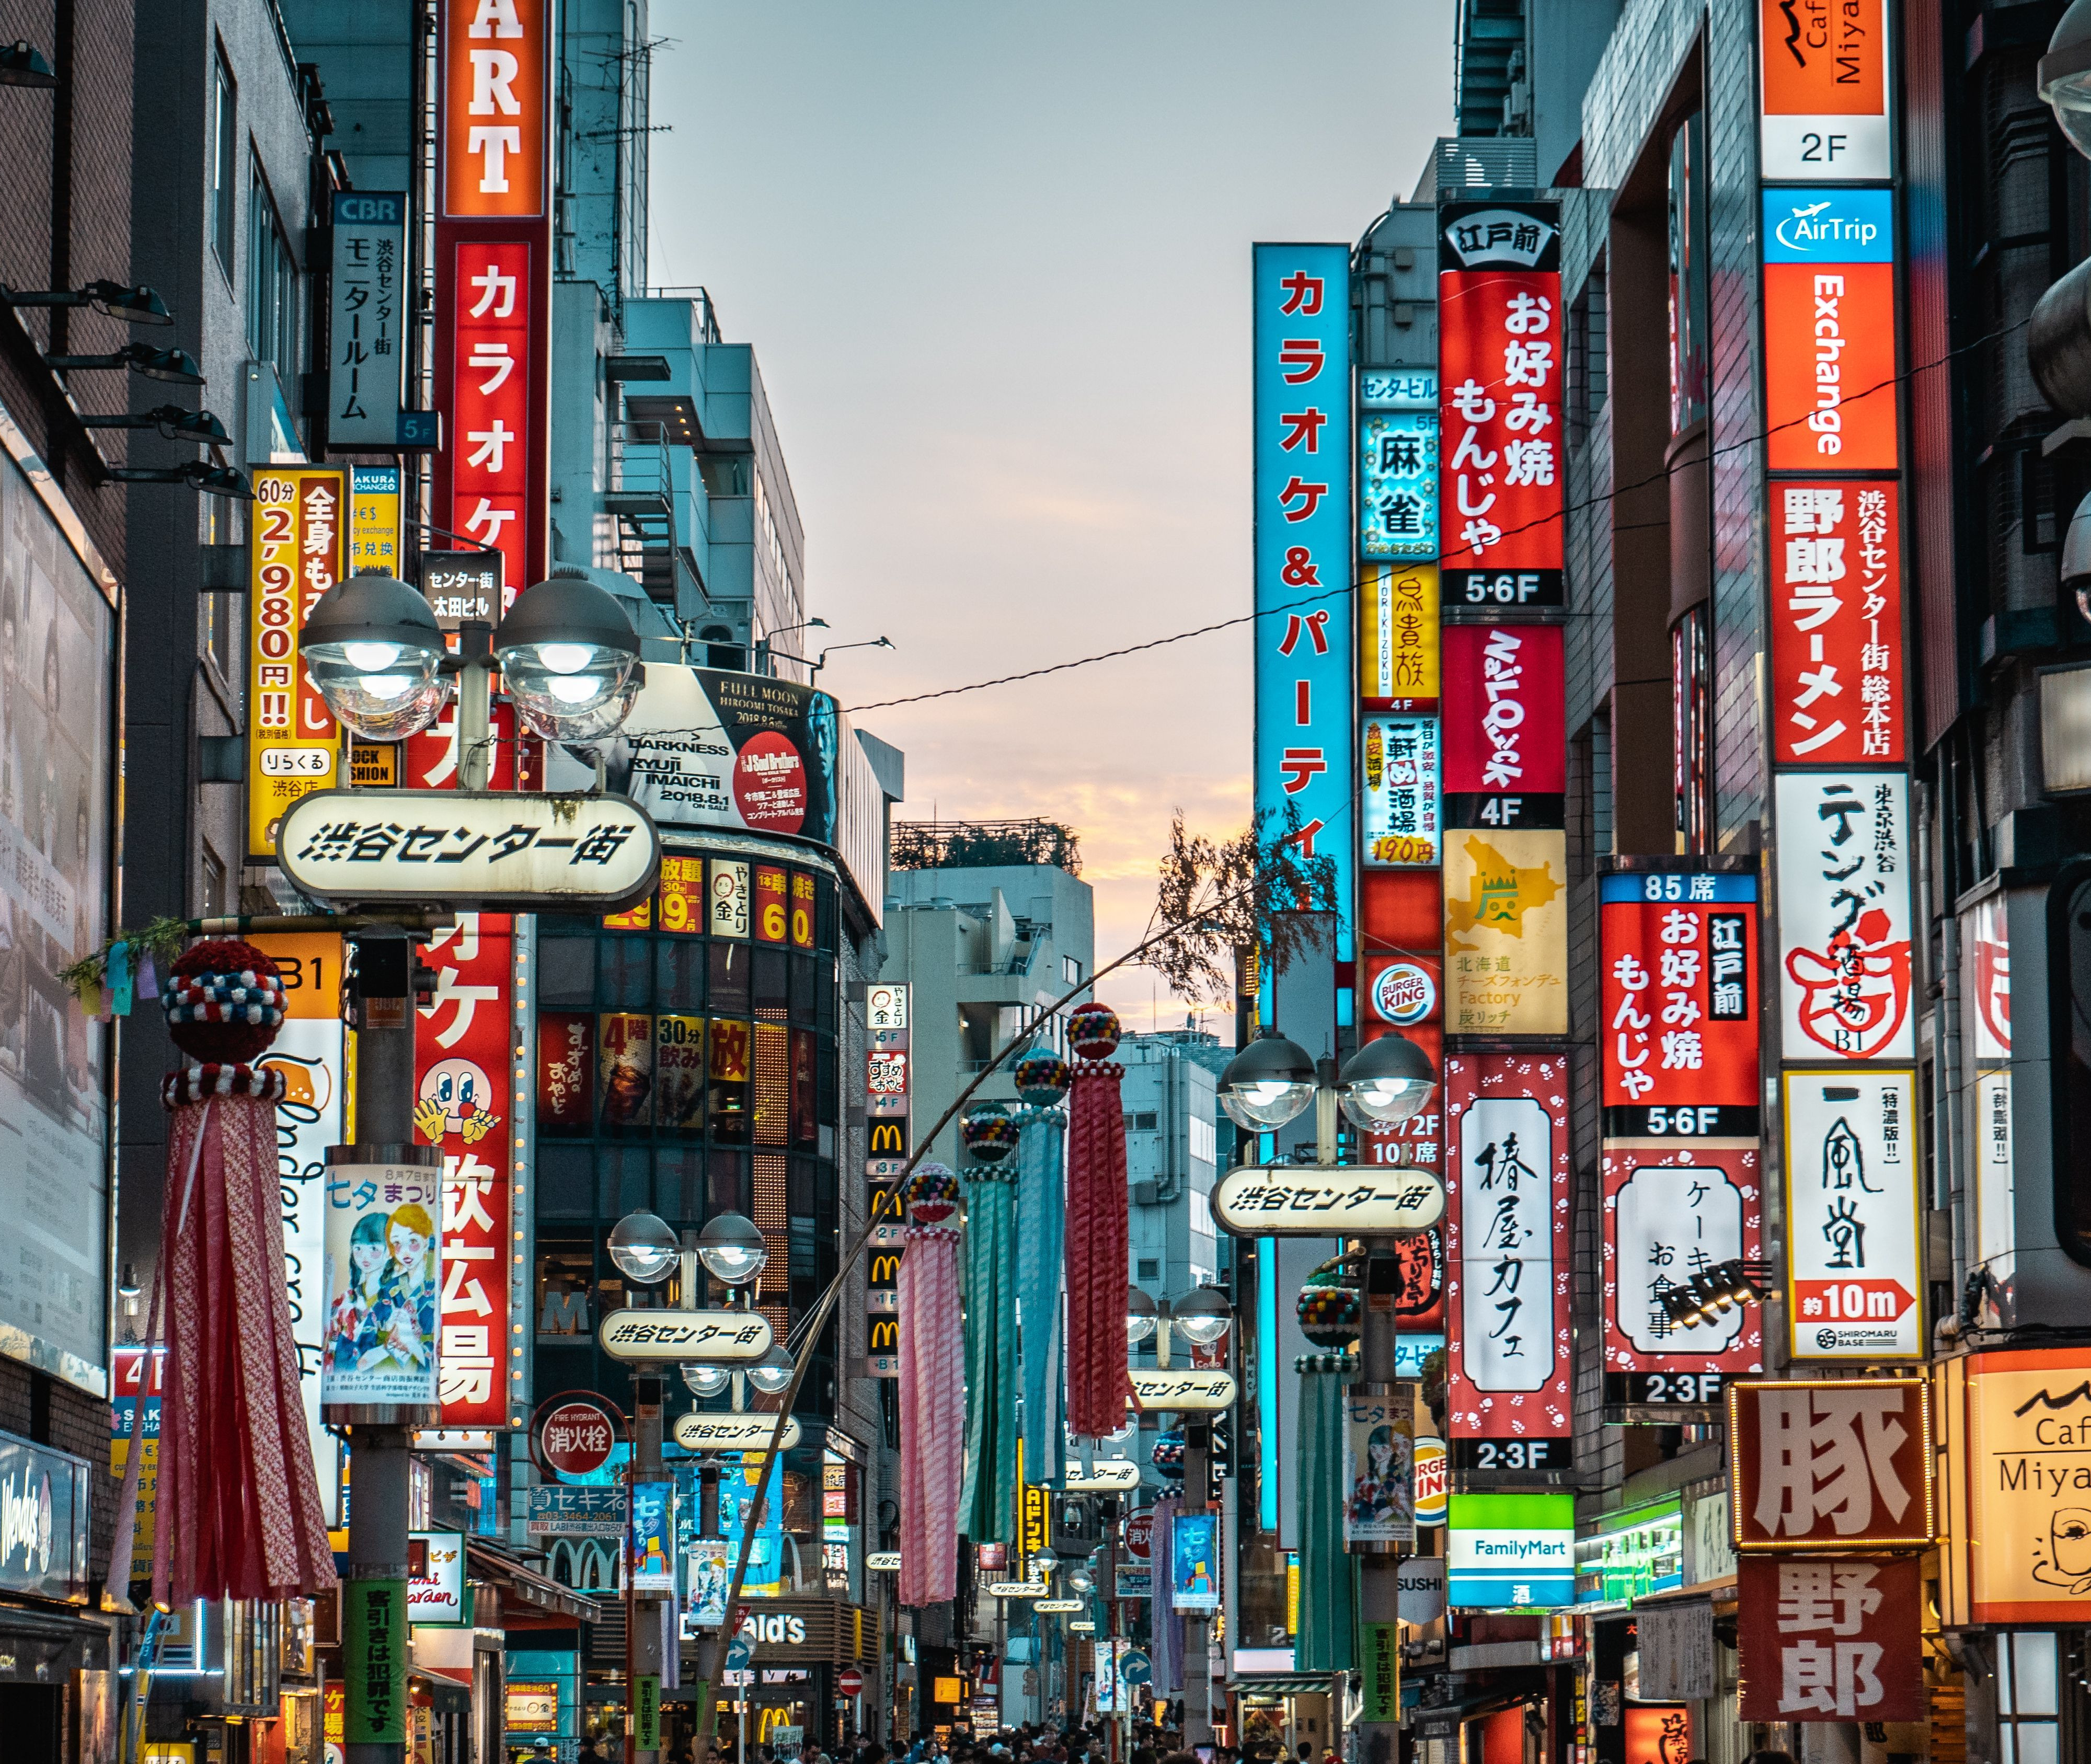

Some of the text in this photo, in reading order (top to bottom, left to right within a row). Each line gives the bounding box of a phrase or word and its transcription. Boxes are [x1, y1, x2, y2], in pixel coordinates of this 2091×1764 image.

[1801, 133, 1847, 162] 2F
[341, 199, 395, 221] CBR
[1457, 222, 1541, 255] 江戸前
[1794, 216, 1877, 246] AirTrip
[374, 238, 394, 356] 渋谷センター街
[342, 238, 372, 419] モニタールーム
[1809, 274, 1845, 455] Exchange
[1362, 378, 1437, 399] センタービル
[1504, 292, 1554, 486] お好み焼
[1451, 378, 1502, 555] もんじゃ
[258, 480, 294, 503] 60分
[1380, 435, 1420, 533] 麻雀
[362, 526, 394, 536] exchange
[352, 541, 393, 556] 币兑换
[430, 572, 495, 589] センター街
[433, 597, 490, 618] 太田ビル
[1381, 577, 1389, 682] TORIKIZOKU
[1784, 489, 1847, 756] 野郎ラーメン
[1857, 489, 1891, 756] 渋谷センター街 総本店
[720, 681, 798, 705] FULL MOON
[1391, 699, 1412, 710] 4F
[720, 697, 798, 717] HIROOMI TOSAKA
[352, 750, 380, 764] OCK
[628, 738, 729, 756] DARKNESS
[267, 754, 324, 770] りらくる
[350, 767, 388, 781] SHION
[646, 774, 720, 790] IMAICHI
[1386, 723, 1418, 833] 一軒め酒場
[660, 790, 729, 805] 2018.8.1
[1481, 798, 1522, 825] 4F
[1874, 784, 1897, 873] 東京渋谷
[296, 822, 636, 865] 渋谷センター街
[1819, 784, 1885, 938] テング
[735, 866, 748, 933] やきとり
[1645, 875, 1716, 901] 85席
[716, 900, 732, 921] 金
[1457, 955, 1511, 972] 北海道
[1711, 919, 1743, 1014] 江戸前
[1382, 976, 1423, 997] BURGER
[1457, 974, 1561, 988] チーズフォンデュ
[1660, 908, 1703, 1070] お好み焼
[1830, 944, 1866, 1022] 酒場
[894, 987, 903, 1027] やきとり
[1383, 987, 1426, 1012] KING
[1460, 991, 1522, 1007] Factory
[875, 1010, 889, 1024] 金
[1613, 954, 1655, 1100] もんじゃ
[660, 1019, 700, 1044] 30分
[879, 1032, 898, 1042] 5F
[1833, 1029, 1863, 1053] B1
[660, 1047, 700, 1069] 飲み
[879, 1097, 898, 1108] 4F
[879, 1162, 898, 1173] 3F
[1821, 1086, 1884, 1268] 一風堂
[326, 1170, 435, 1211] 七夕 まつり
[1230, 1185, 1434, 1211] 渋谷センター街
[1687, 1180, 1712, 1272] ケーキ
[1474, 1132, 1538, 1358] 椿屋カフェ
[610, 1323, 767, 1345] 渋谷センター街
[555, 1413, 569, 1422] FIRE
[1349, 1400, 1385, 1424] 七夕
[550, 1425, 607, 1453] 消火栓
[1753, 1387, 1911, 1538] 豚
[1129, 1528, 1153, 1545] 消火
[430, 1550, 458, 1563] ピザ
[1476, 1540, 1566, 1559] FamilyMart
[1397, 1577, 1442, 1592] SUSHI
[1512, 1585, 1532, 1605] 酒
[408, 1591, 458, 1607] arden
[1777, 1563, 1884, 1716] 野郎
[367, 1590, 390, 1732] 客引きは犯罪です
